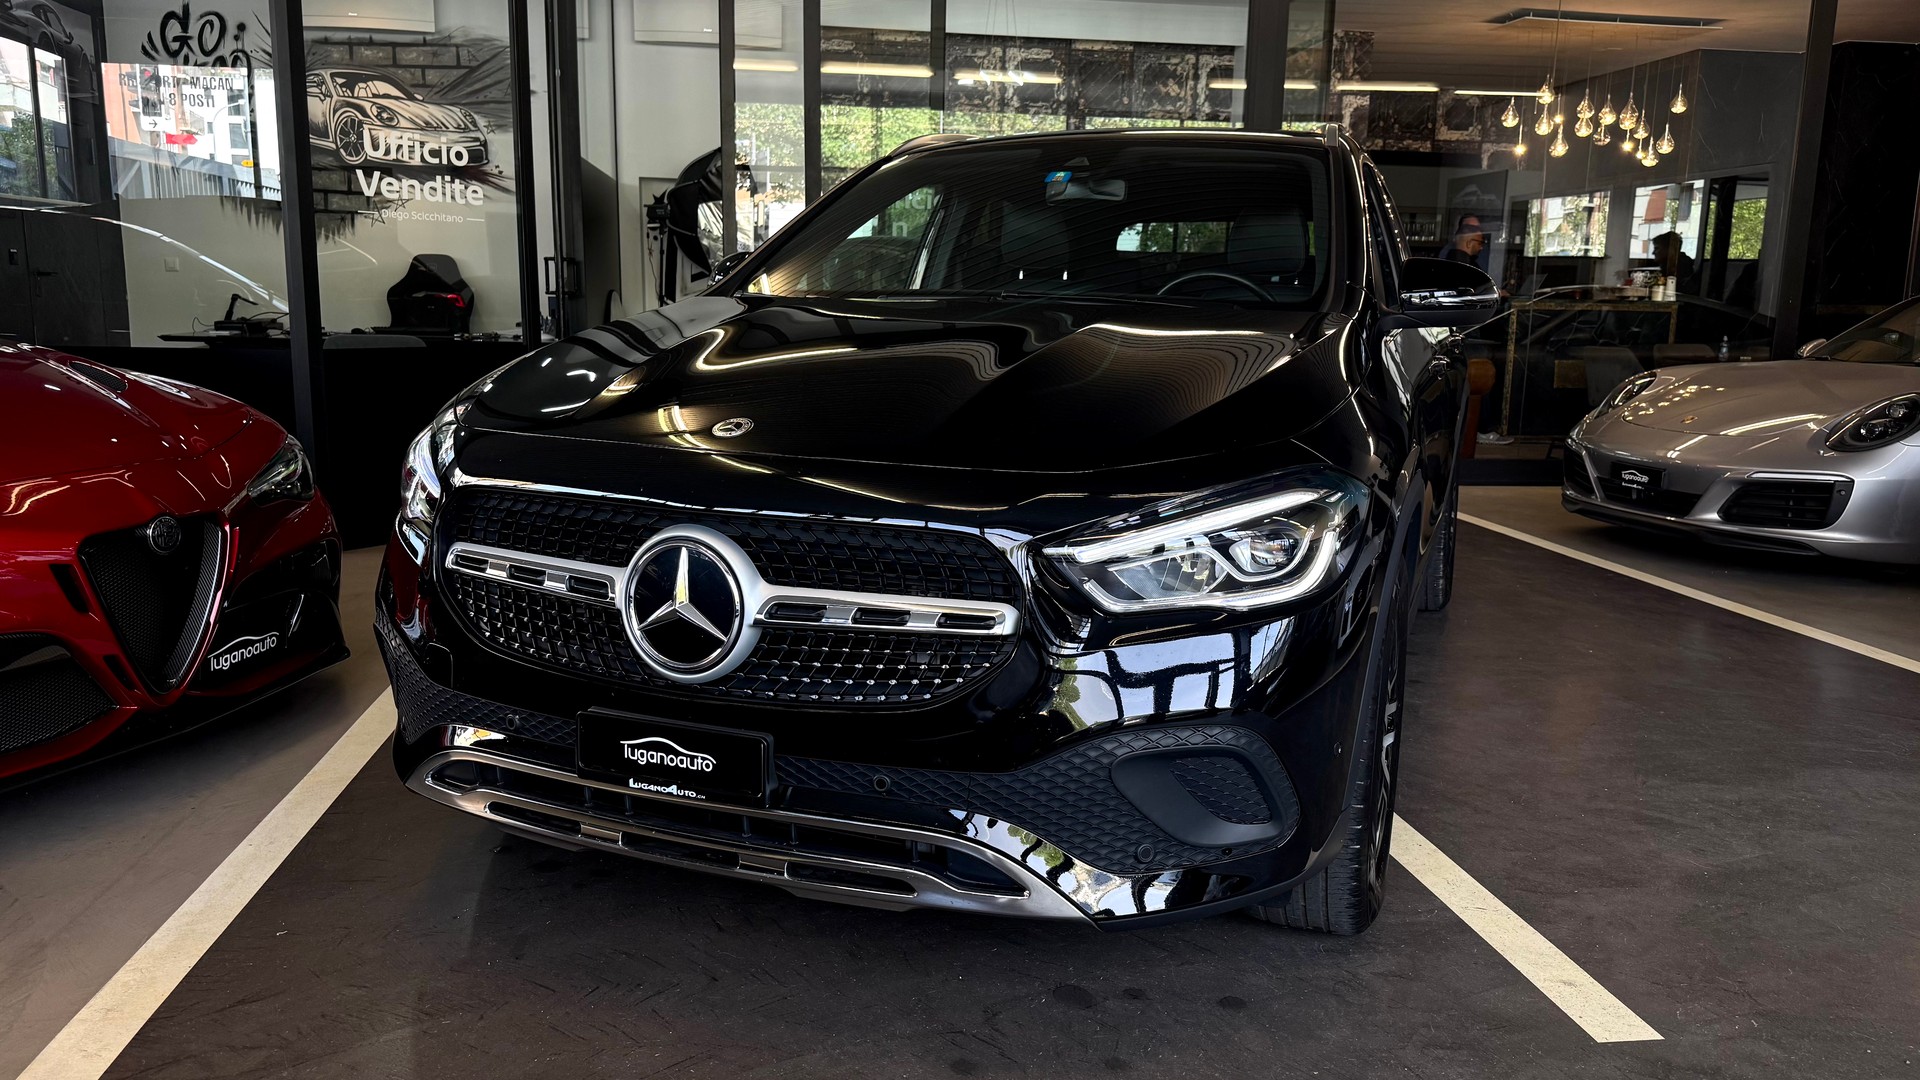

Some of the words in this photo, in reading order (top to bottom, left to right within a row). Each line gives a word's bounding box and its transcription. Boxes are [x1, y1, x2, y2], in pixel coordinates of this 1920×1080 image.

[190, 77, 233, 91] MACAN
[363, 124, 469, 166] Ufficio
[356, 169, 484, 206] Vendite
[381, 208, 410, 220] Diego
[411, 211, 464, 223] Scicchitano
